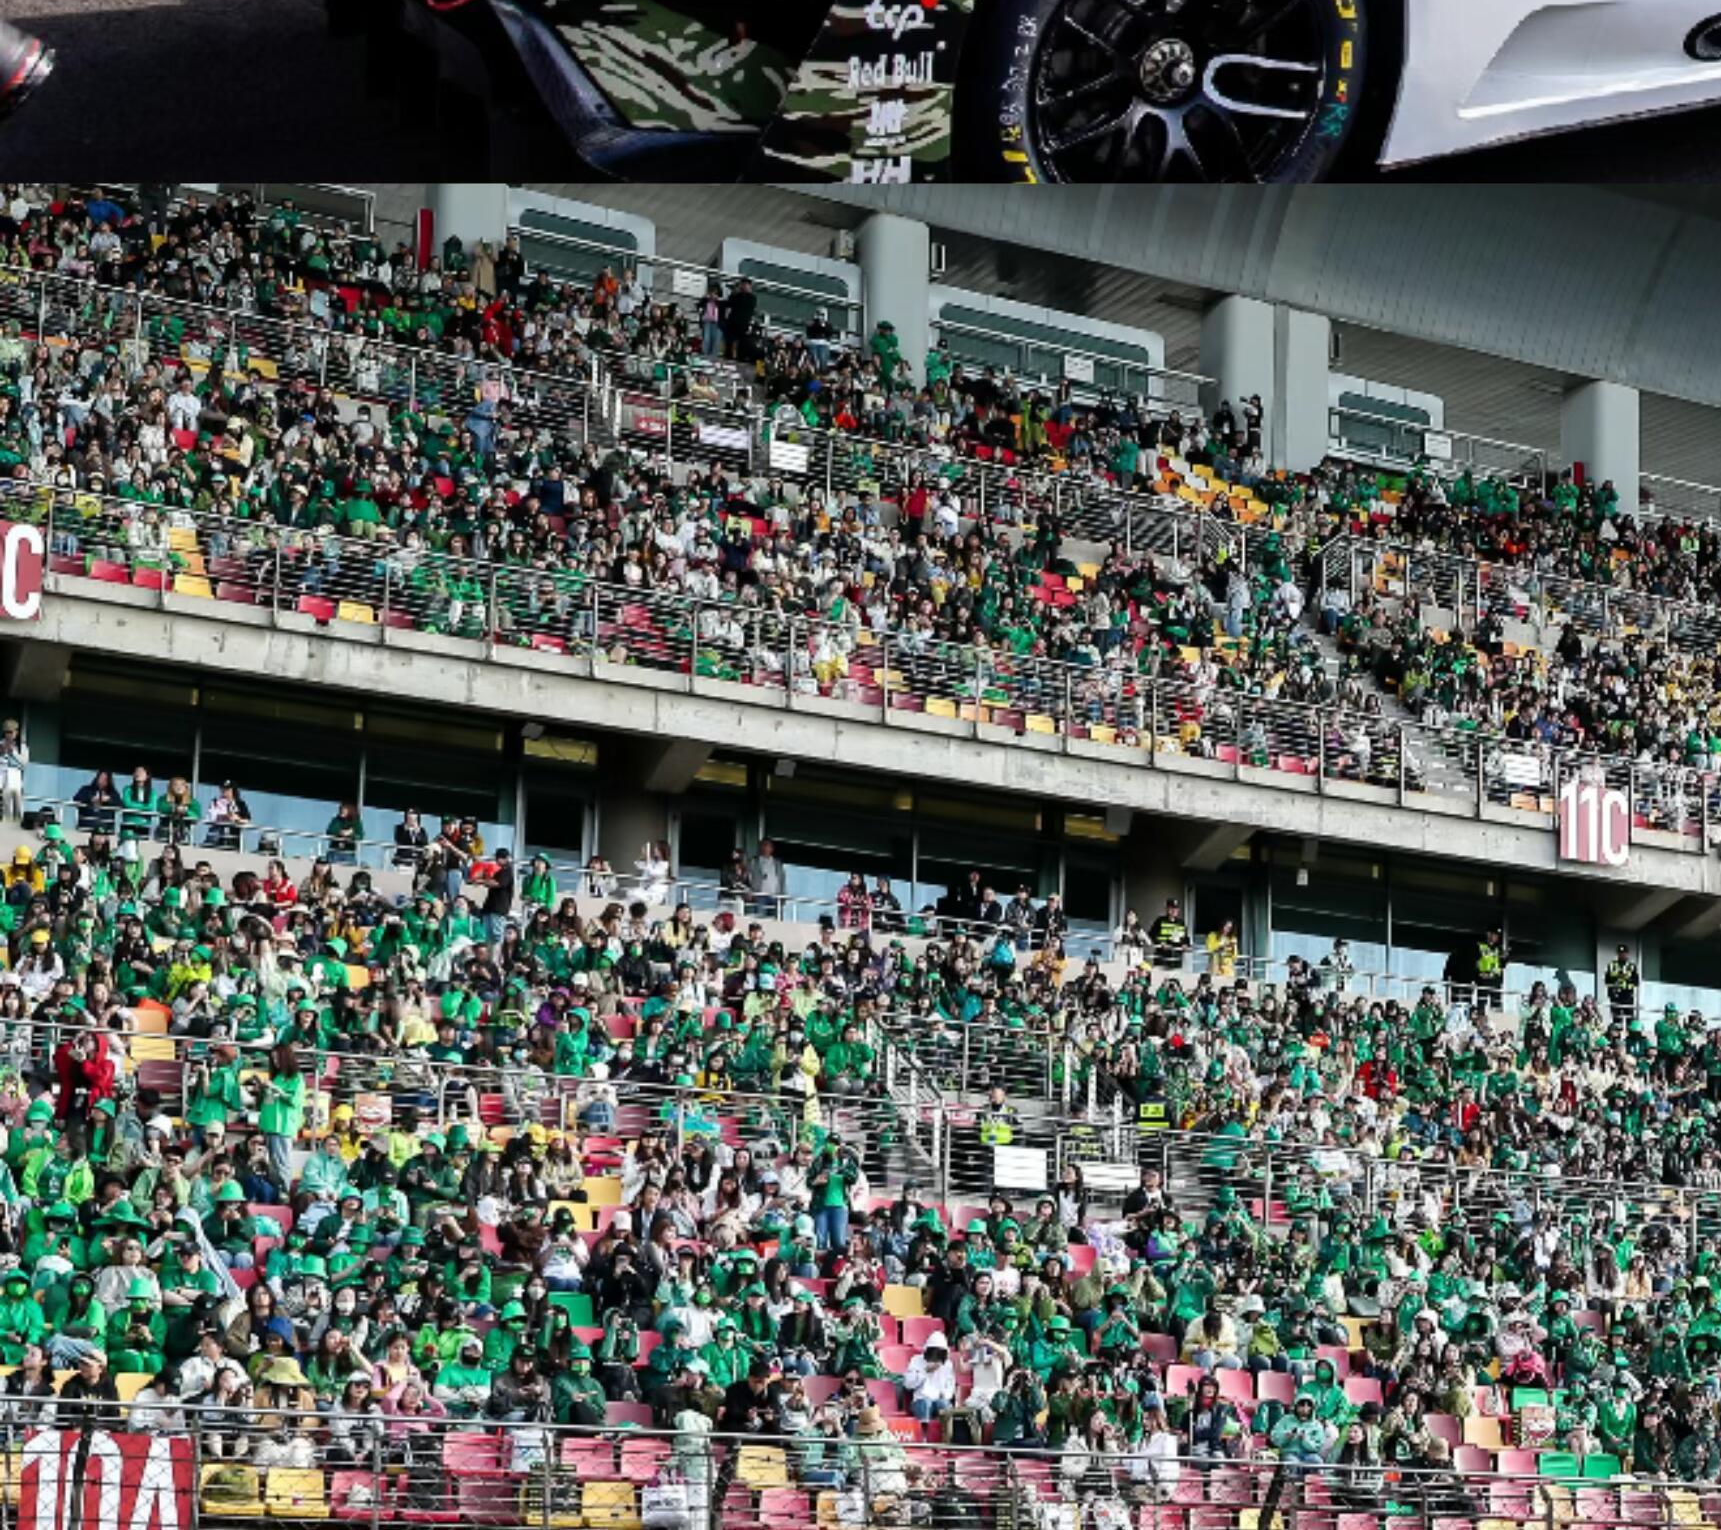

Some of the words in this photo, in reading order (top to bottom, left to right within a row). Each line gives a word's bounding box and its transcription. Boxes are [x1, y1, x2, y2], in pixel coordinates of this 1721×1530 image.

[848, 53, 888, 89] Red
[892, 51, 935, 85] Bull
[1560, 780, 1630, 866] 11C
[20, 1428, 181, 1530] 10A
